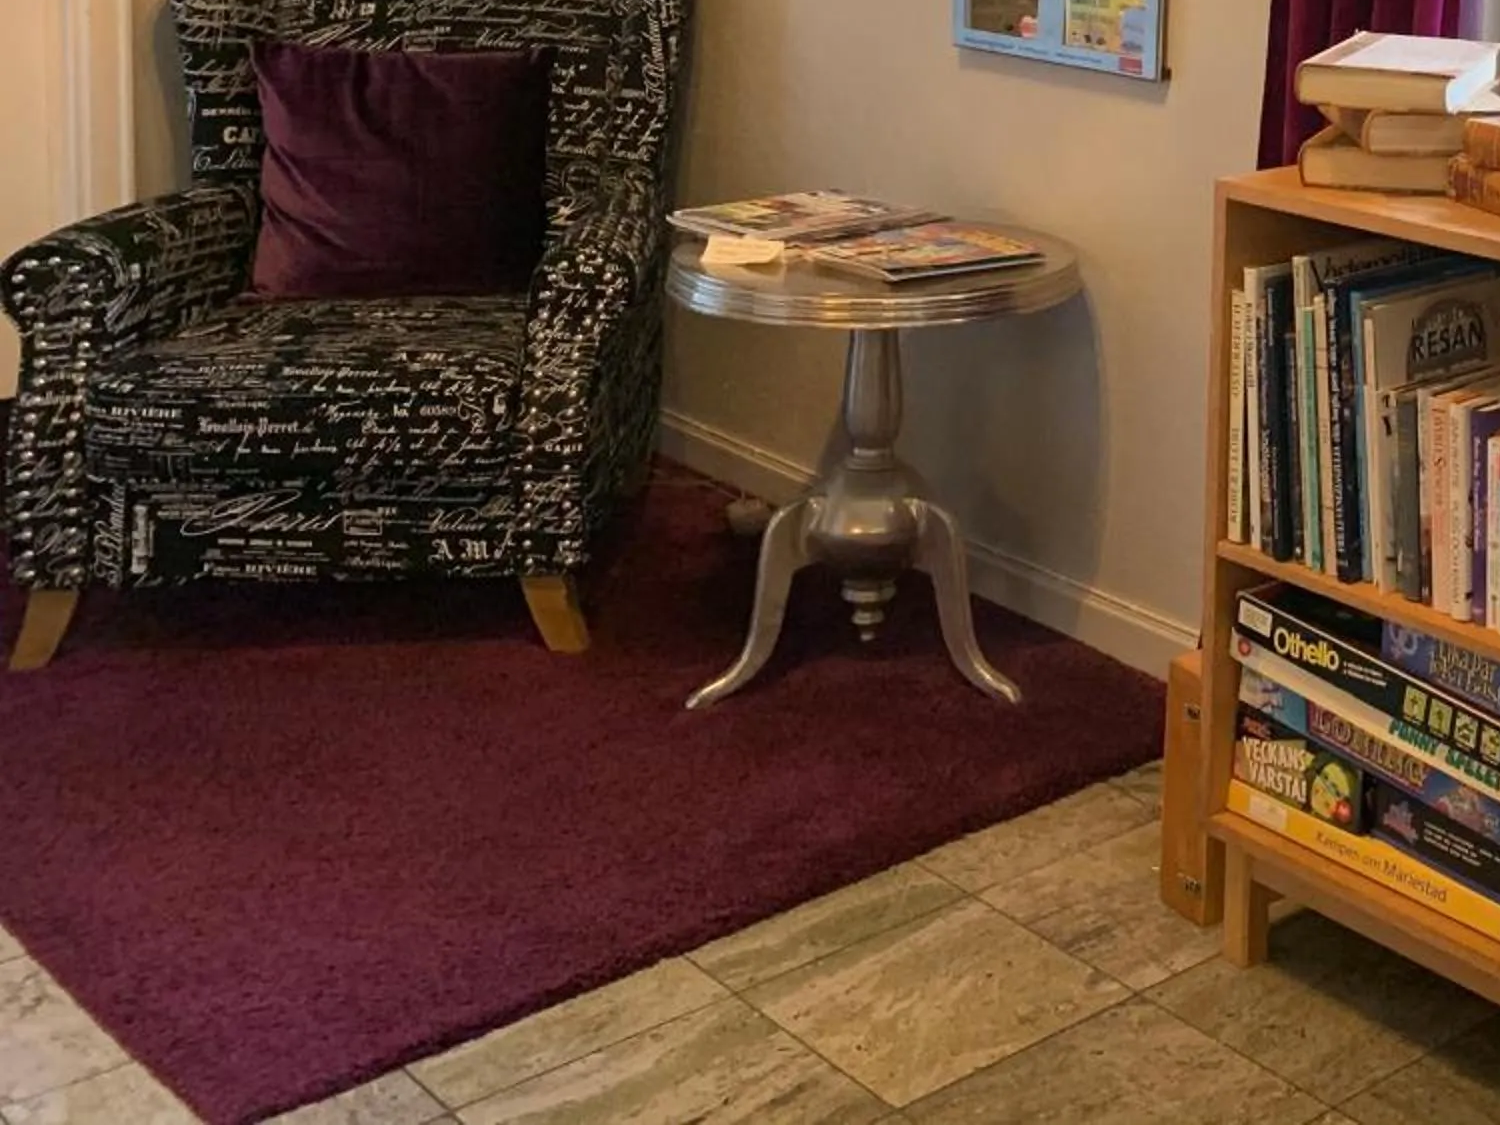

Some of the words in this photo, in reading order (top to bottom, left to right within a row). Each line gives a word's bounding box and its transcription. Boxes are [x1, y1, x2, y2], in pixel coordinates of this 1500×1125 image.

[1273, 627, 1340, 671] Othello
[1242, 736, 1307, 772] VECKANS
[1382, 858, 1448, 903] Mariestad
